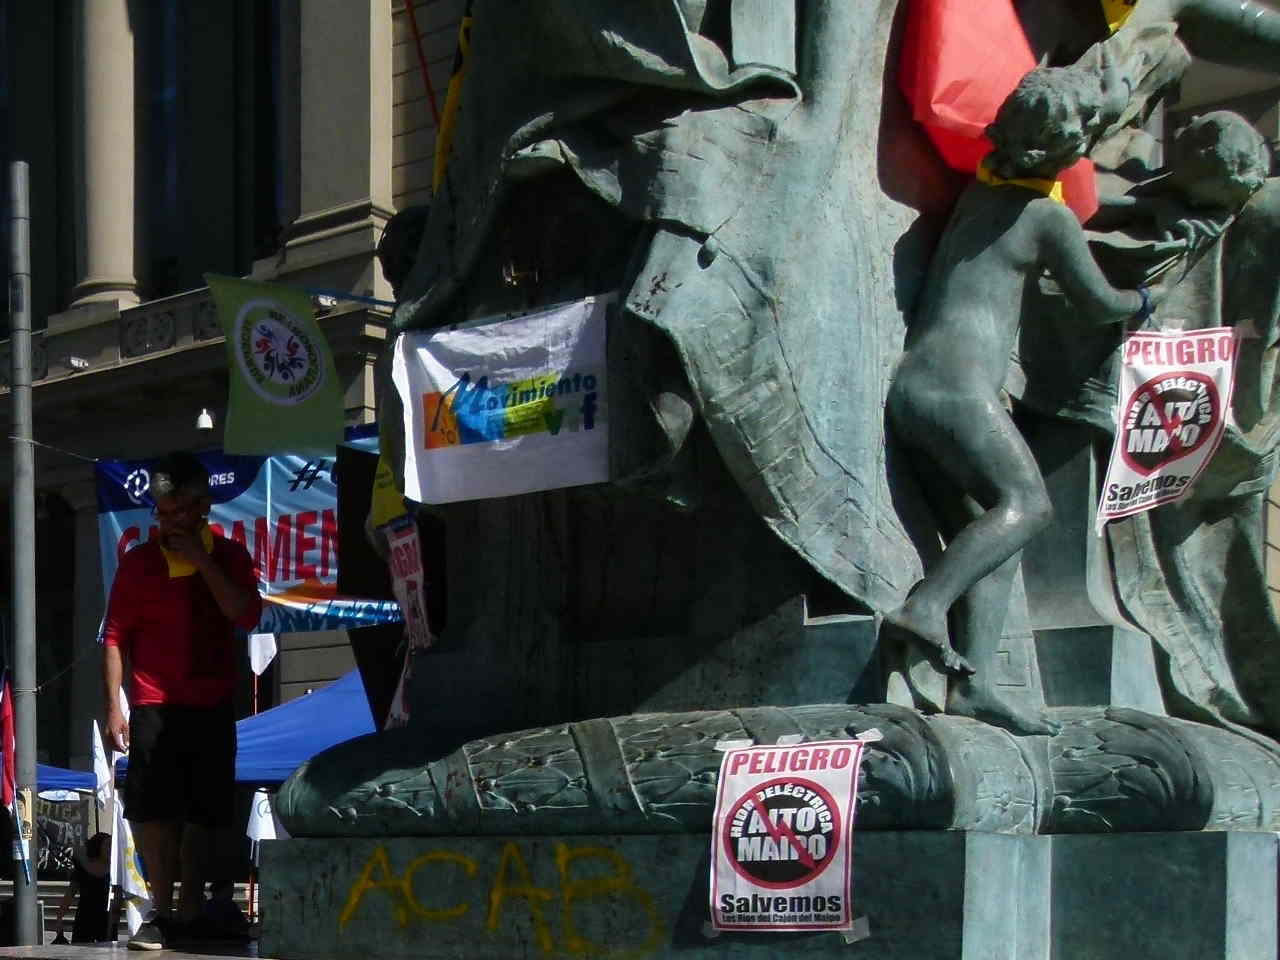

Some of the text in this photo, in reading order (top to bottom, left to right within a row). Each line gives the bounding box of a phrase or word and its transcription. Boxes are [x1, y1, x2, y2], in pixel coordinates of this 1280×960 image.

[1126, 336, 1233, 366] PELIGRO
[729, 748, 851, 775] PELIGRO
[339, 841, 664, 960] ACAB
[721, 893, 841, 913] Salvemos
